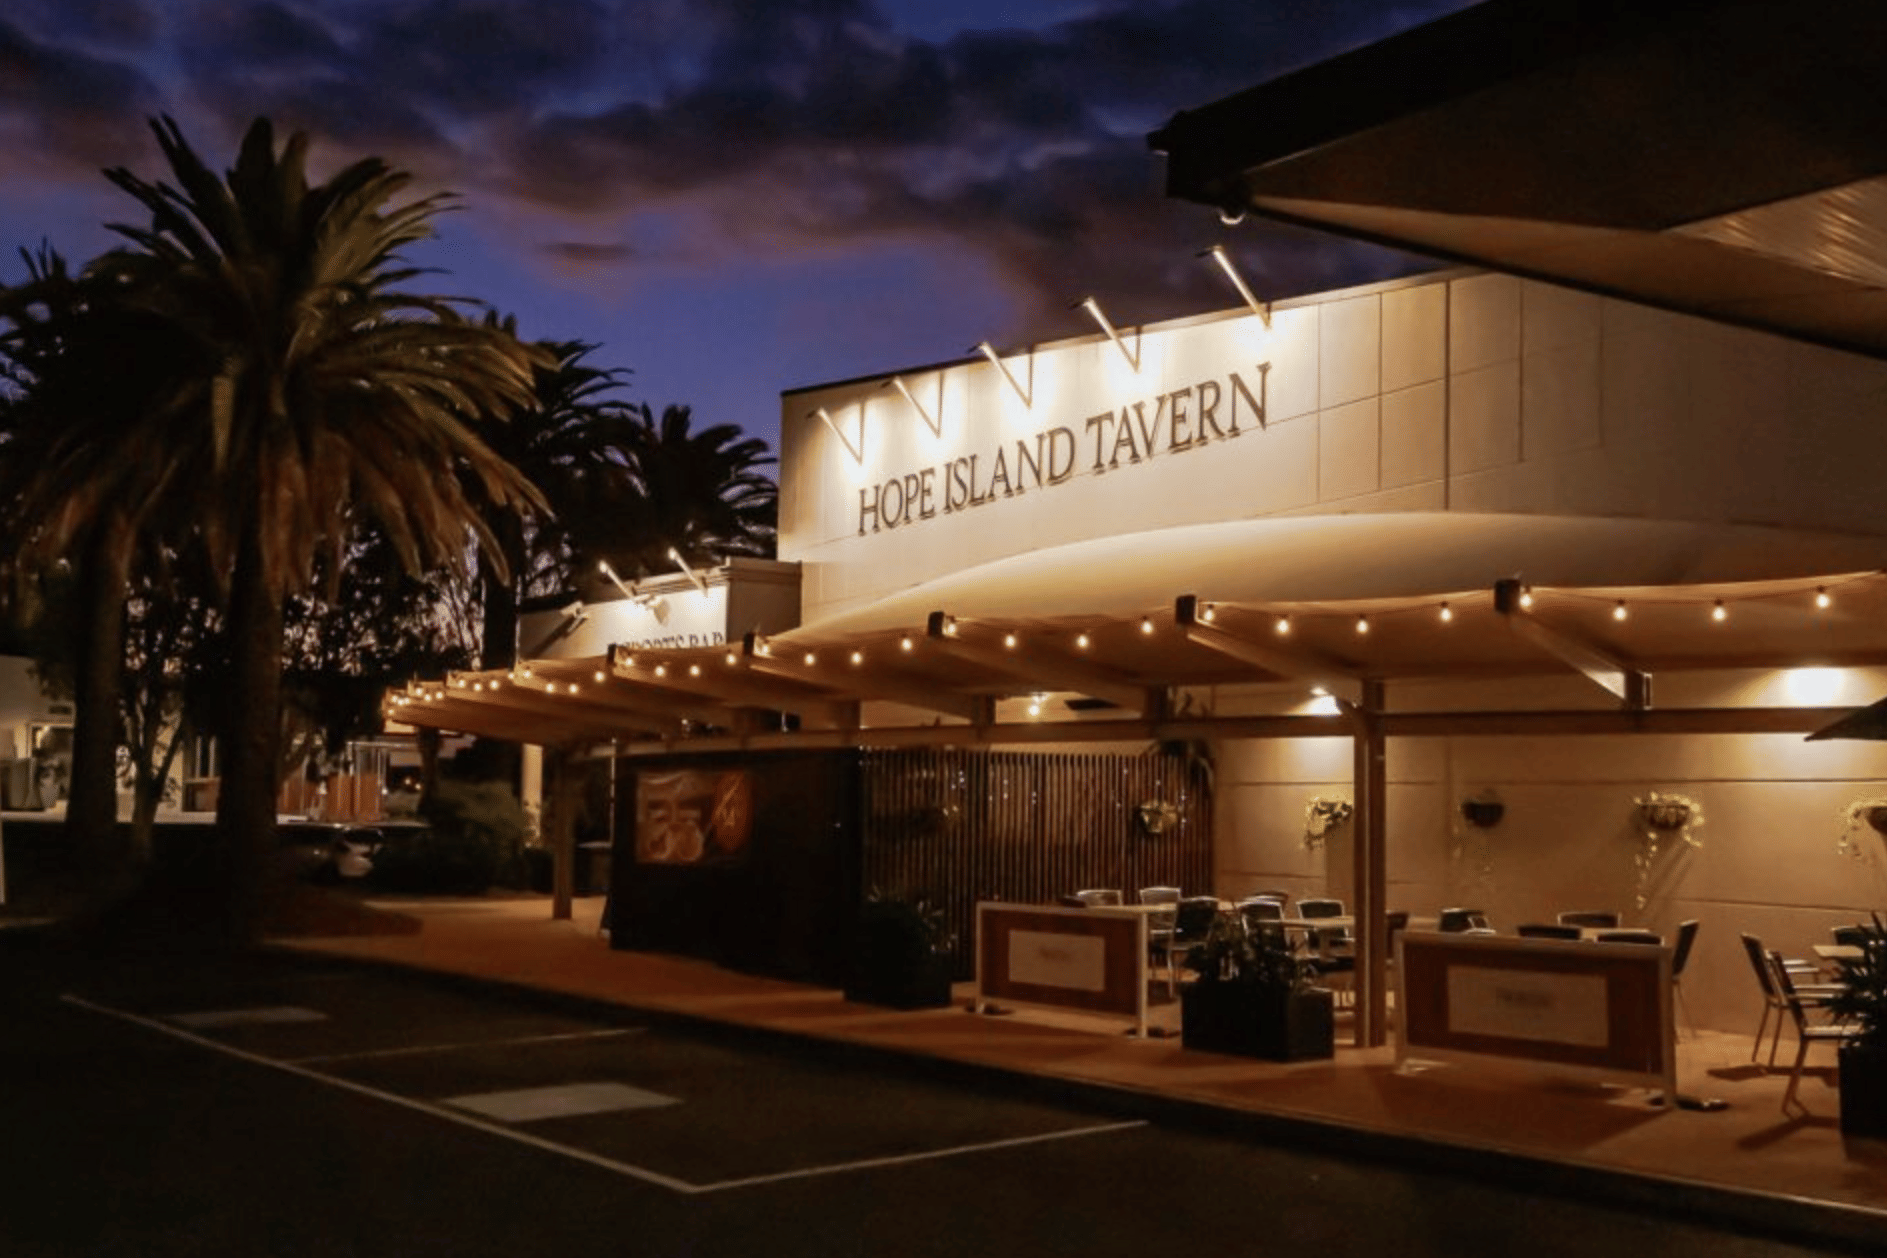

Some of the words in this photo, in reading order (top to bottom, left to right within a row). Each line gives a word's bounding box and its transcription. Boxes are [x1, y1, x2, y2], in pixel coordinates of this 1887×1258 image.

[858, 468, 935, 536] HOPE
[944, 426, 1077, 513] ISLAND
[1085, 362, 1270, 473] TAVERN
